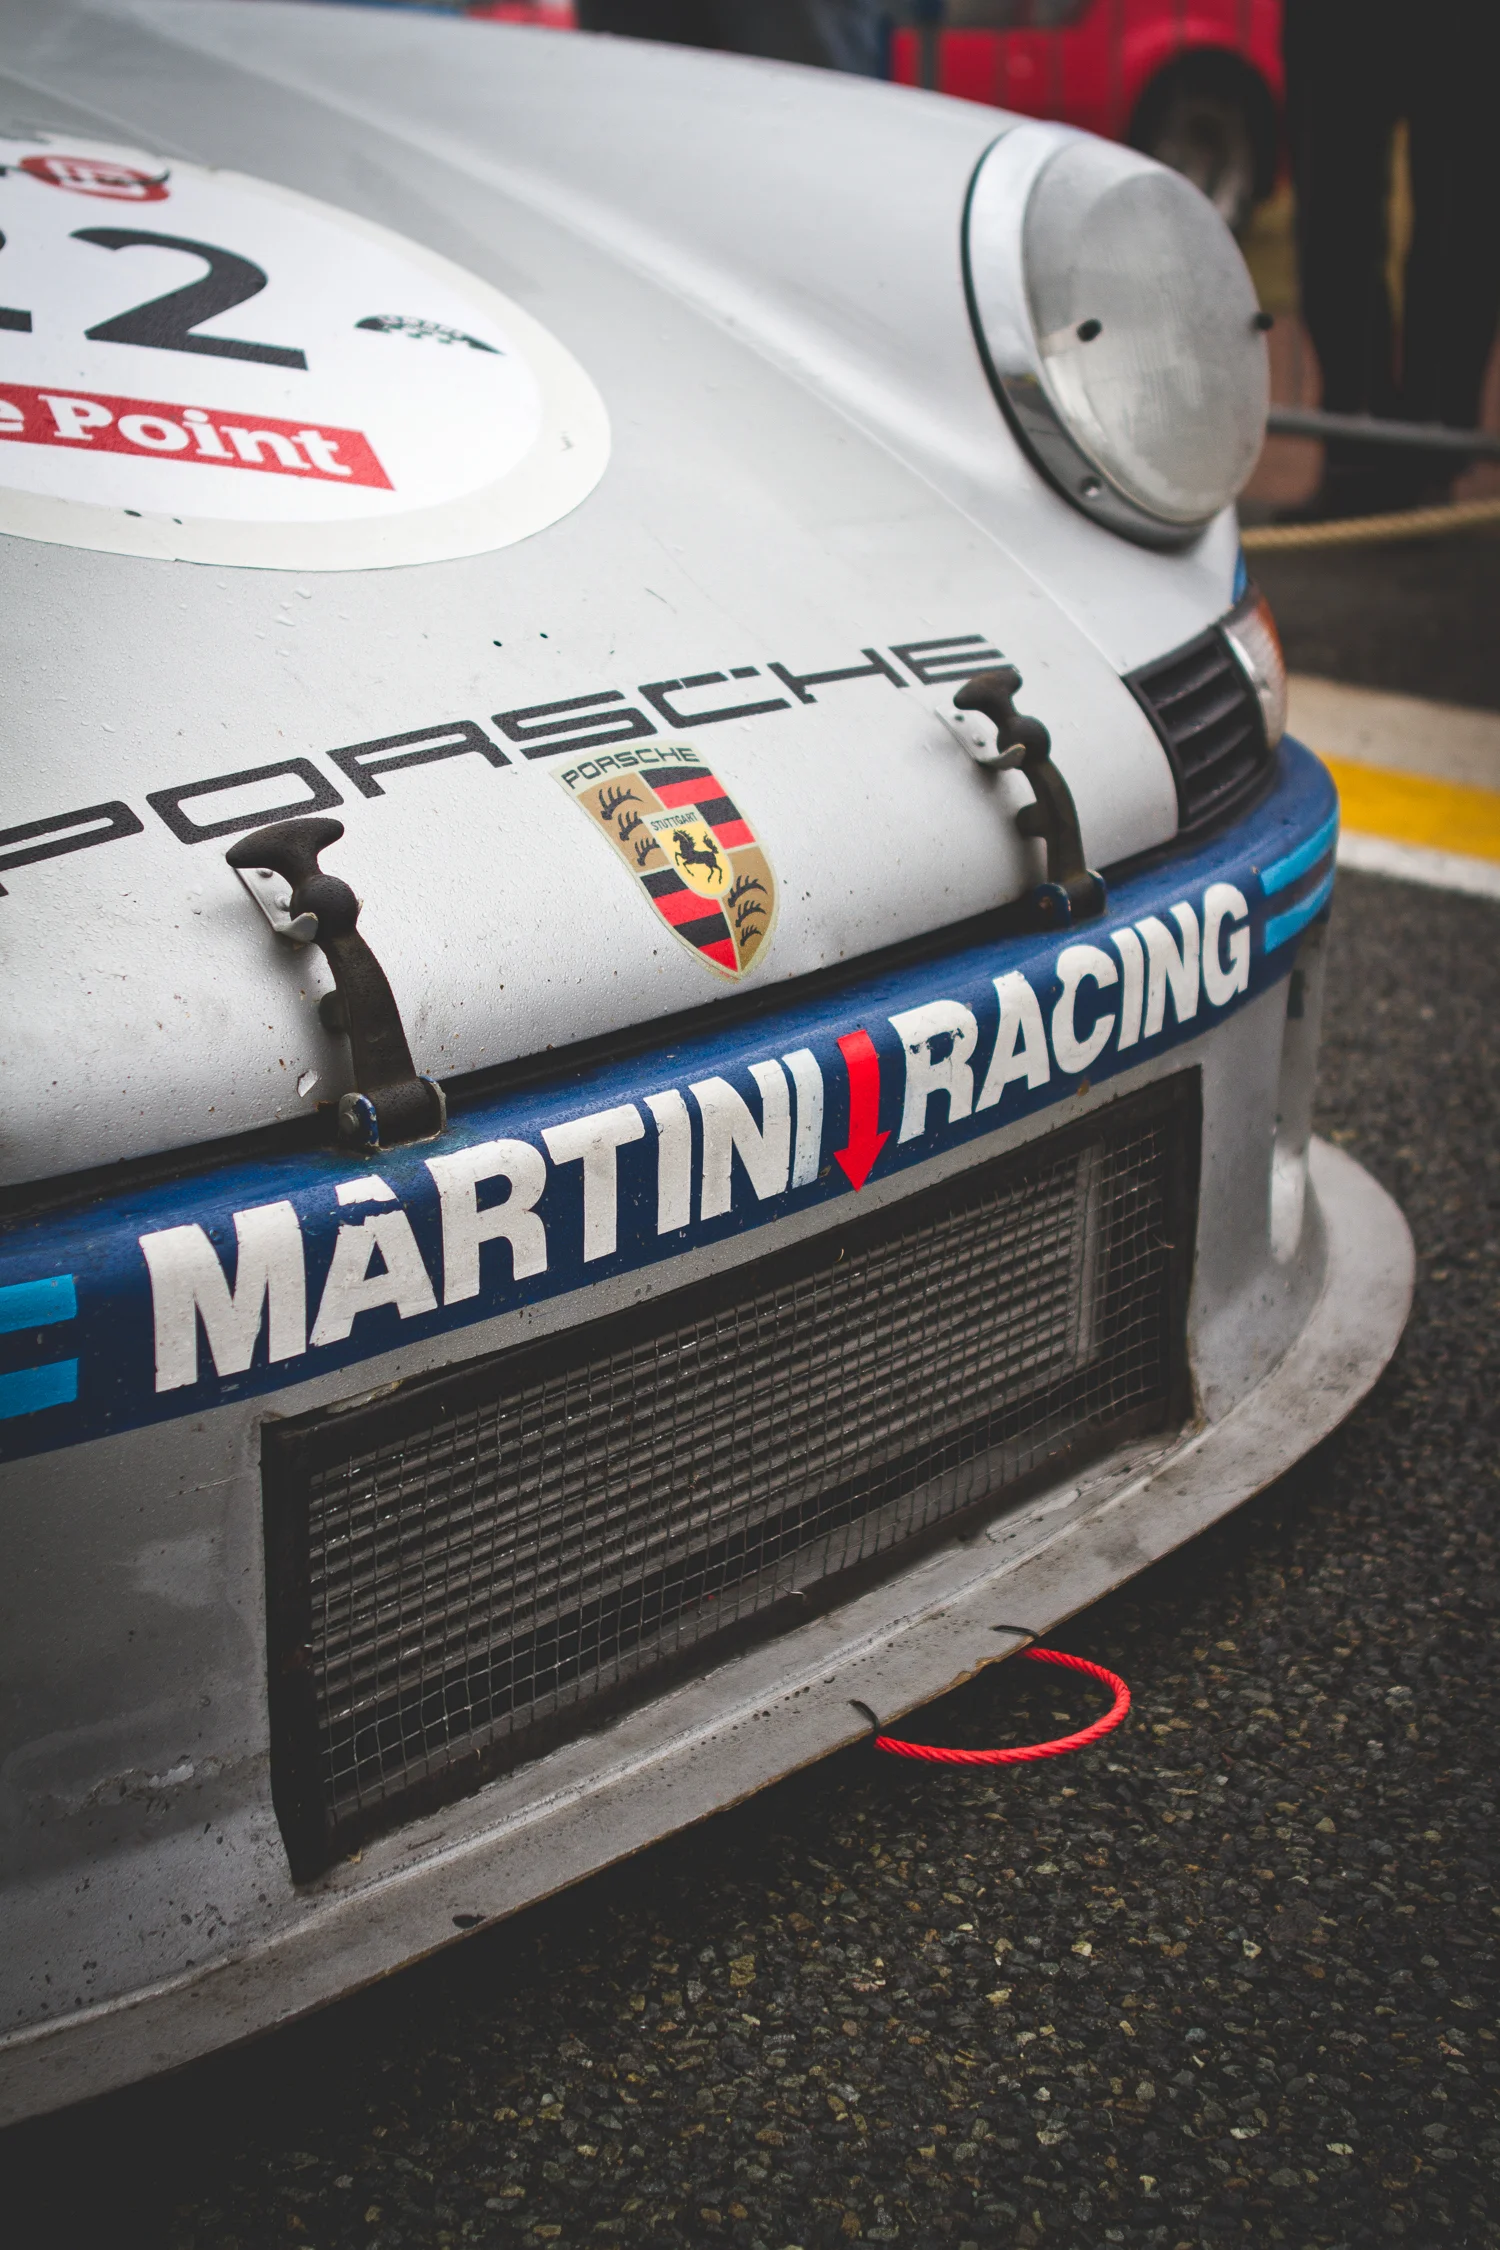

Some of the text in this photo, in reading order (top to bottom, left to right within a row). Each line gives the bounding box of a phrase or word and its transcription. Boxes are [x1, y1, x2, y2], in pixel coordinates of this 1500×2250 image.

[0, 228, 307, 370] 2
[39, 395, 351, 476] Point
[0, 634, 1016, 897] PORSCHE
[561, 747, 700, 789] PORSCHE
[650, 811, 698, 831] STUTTGART
[139, 882, 1251, 1393] MARTINI RACING
